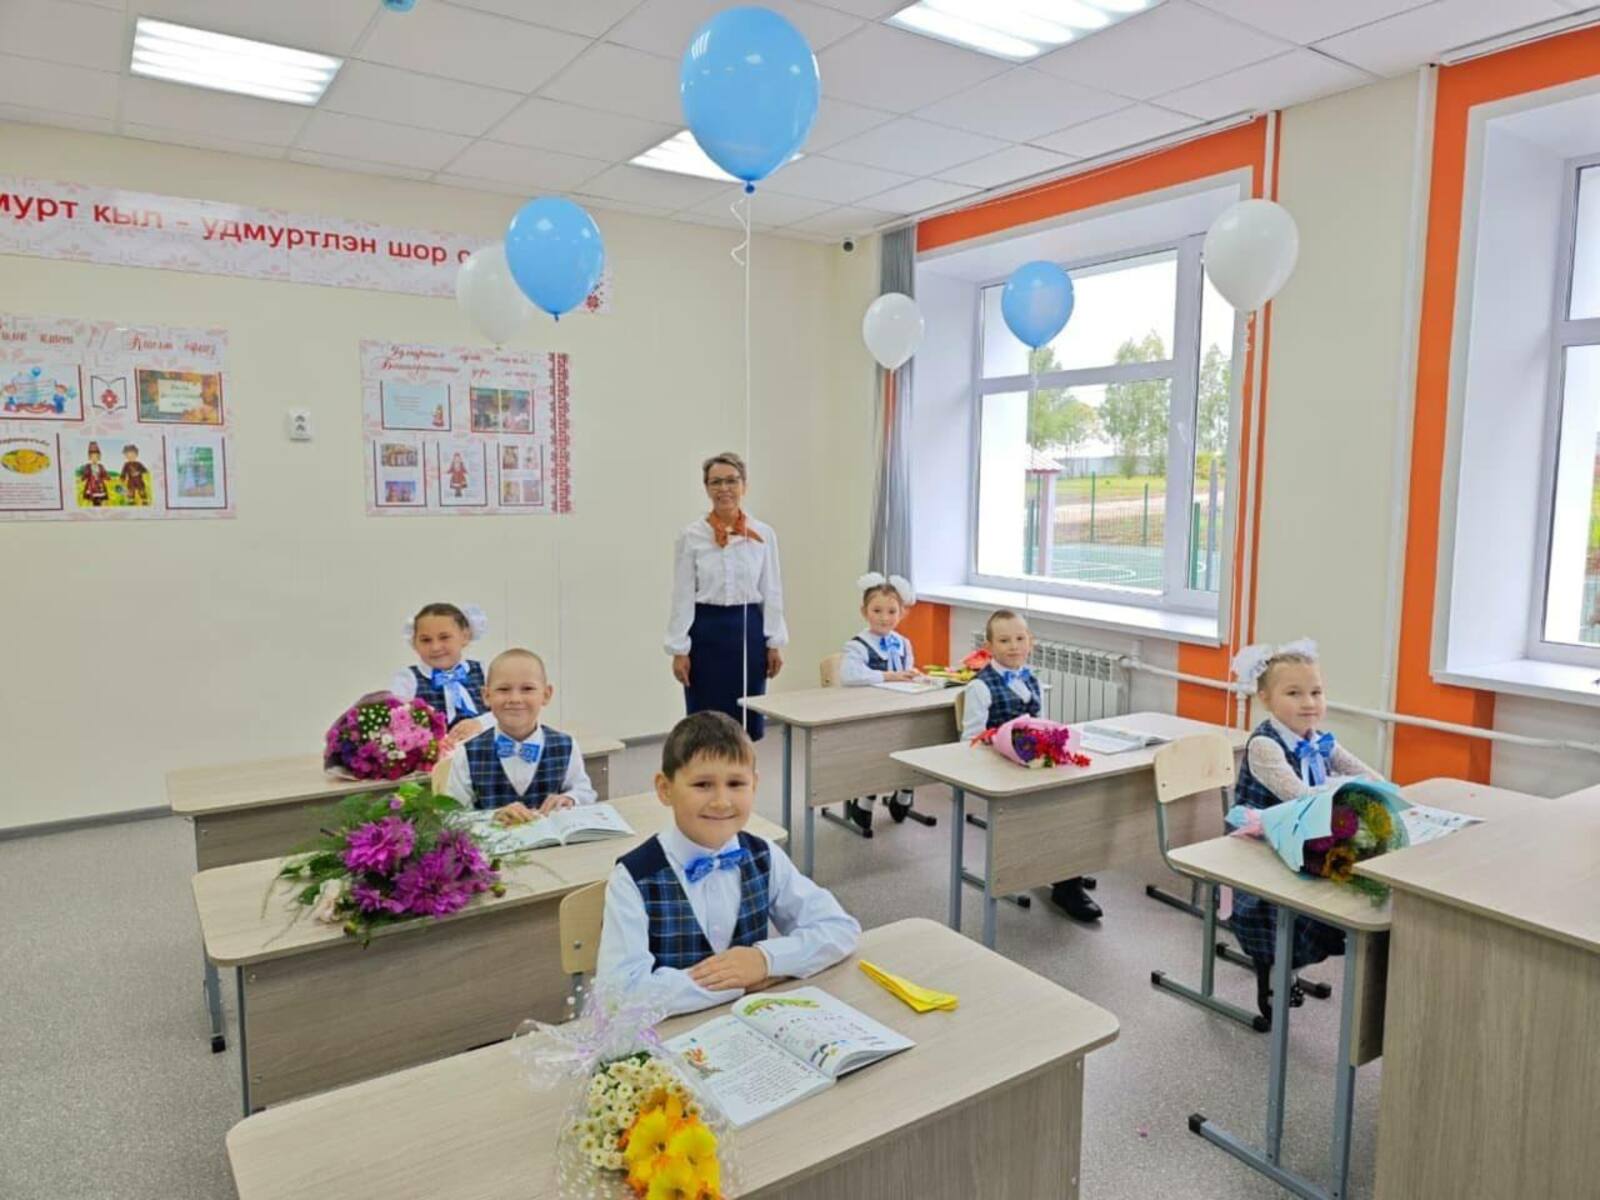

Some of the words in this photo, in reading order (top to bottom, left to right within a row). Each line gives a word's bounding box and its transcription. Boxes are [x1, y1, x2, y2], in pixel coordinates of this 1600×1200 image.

[93, 204, 163, 229] кыл
[201, 216, 377, 254] удмуртлэн
[388, 239, 447, 266] шор
